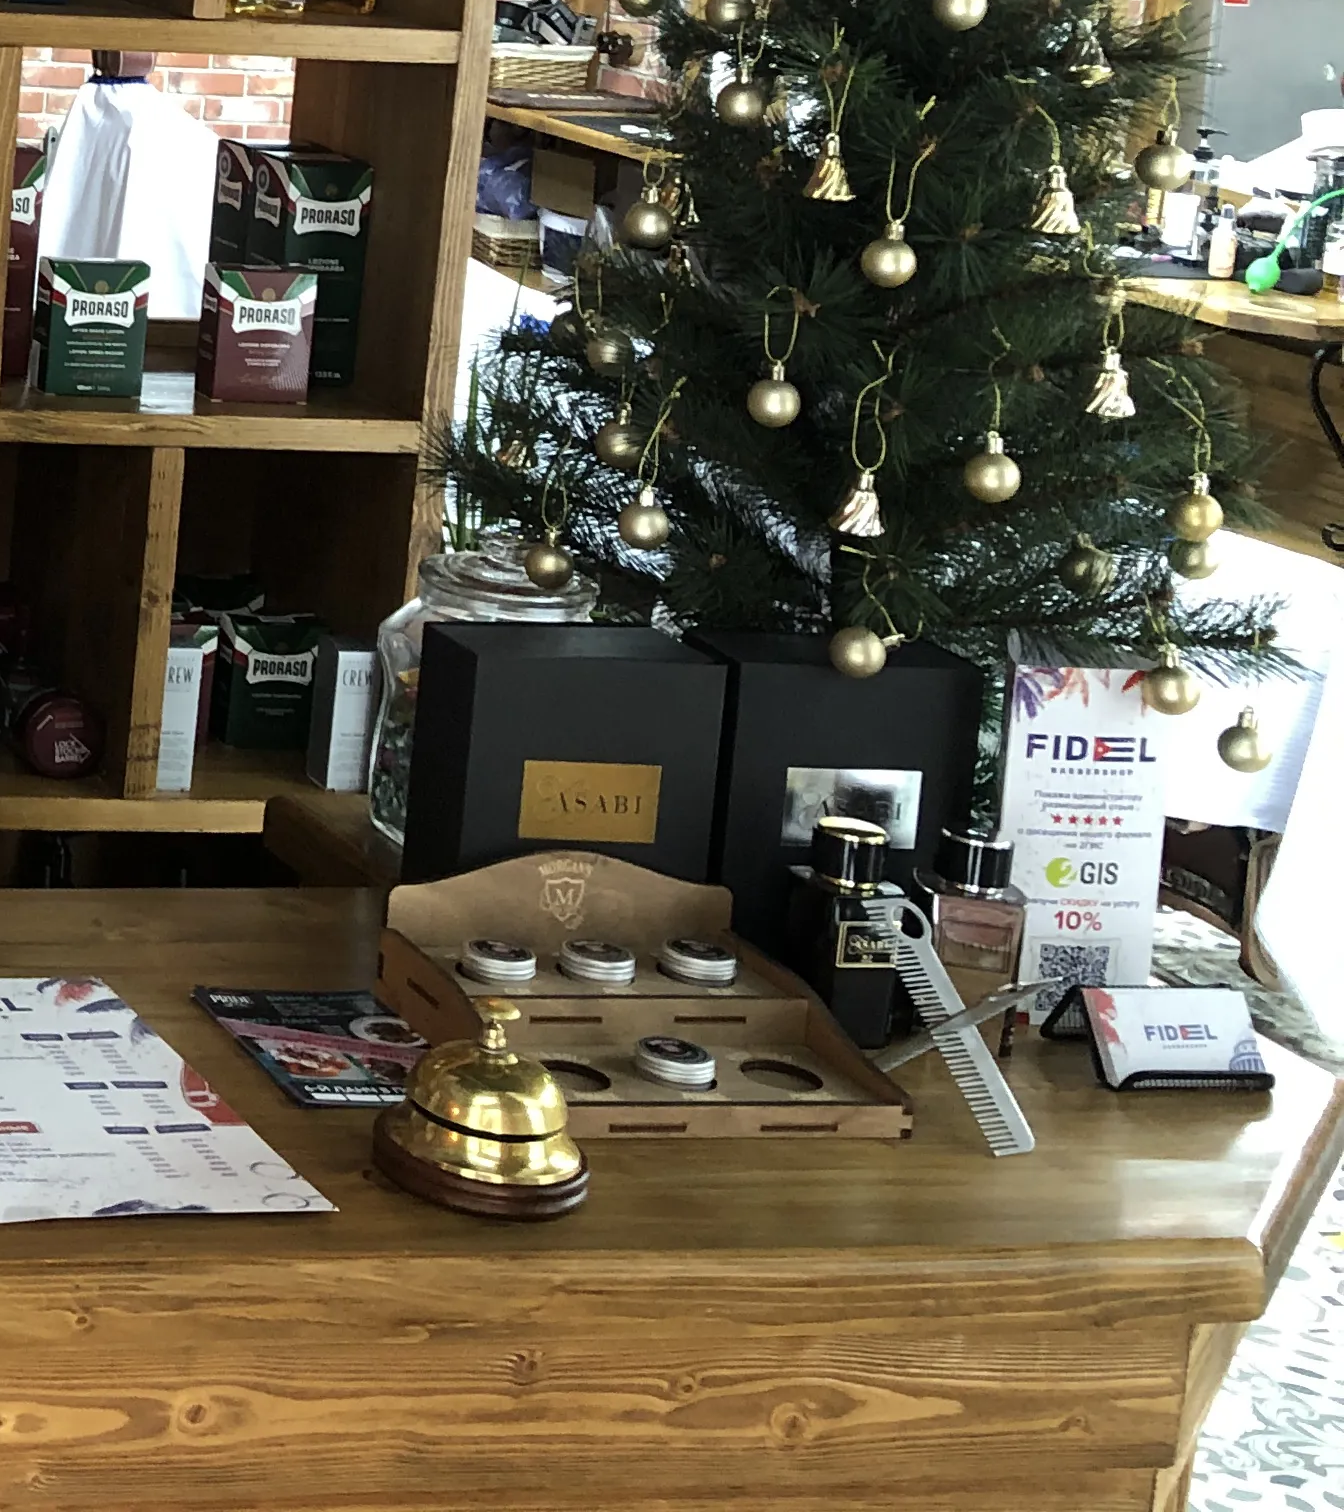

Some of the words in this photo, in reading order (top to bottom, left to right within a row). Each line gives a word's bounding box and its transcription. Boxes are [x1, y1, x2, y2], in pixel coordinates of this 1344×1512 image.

[300, 207, 356, 227] PRORASO
[71, 298, 130, 318] PRORASO
[238, 306, 296, 325] PRORASO
[168, 666, 195, 684] REW
[253, 658, 309, 678] PRORASO
[1025, 733, 1157, 763] FIDEL
[554, 791, 642, 814] ASABI
[555, 888, 575, 906] M
[1053, 909, 1103, 933] 10%
[1144, 1023, 1218, 1043] FIDEL
